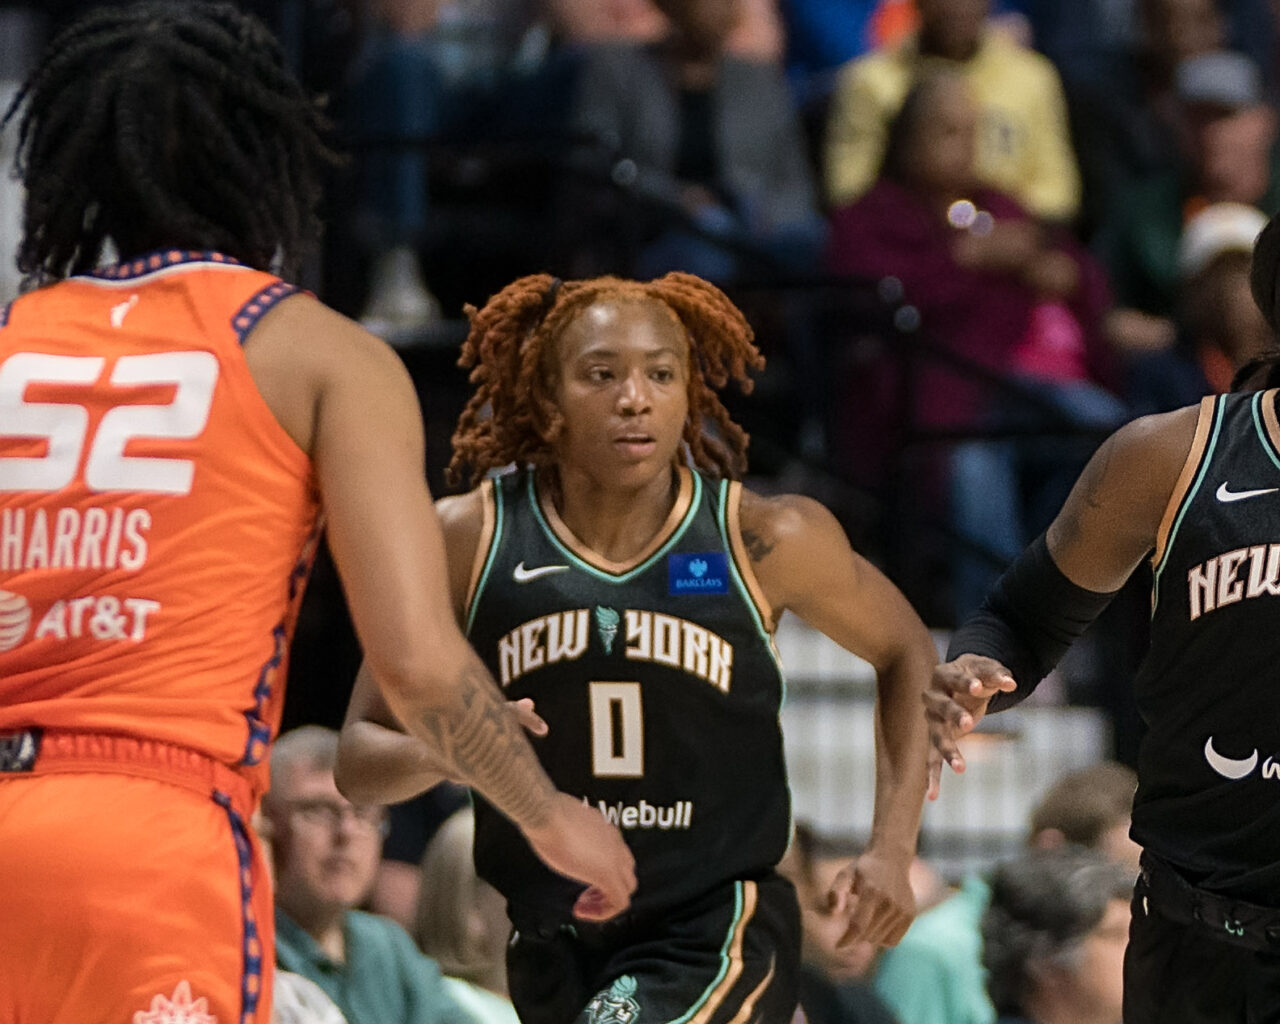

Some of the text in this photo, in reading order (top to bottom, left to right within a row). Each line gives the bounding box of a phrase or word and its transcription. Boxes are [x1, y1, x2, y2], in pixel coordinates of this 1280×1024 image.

[0, 351, 219, 494] 52
[2, 508, 151, 571] HARRIS
[35, 596, 161, 642] AT&T
[498, 608, 733, 694] NEW YORK
[588, 681, 644, 778] 0
